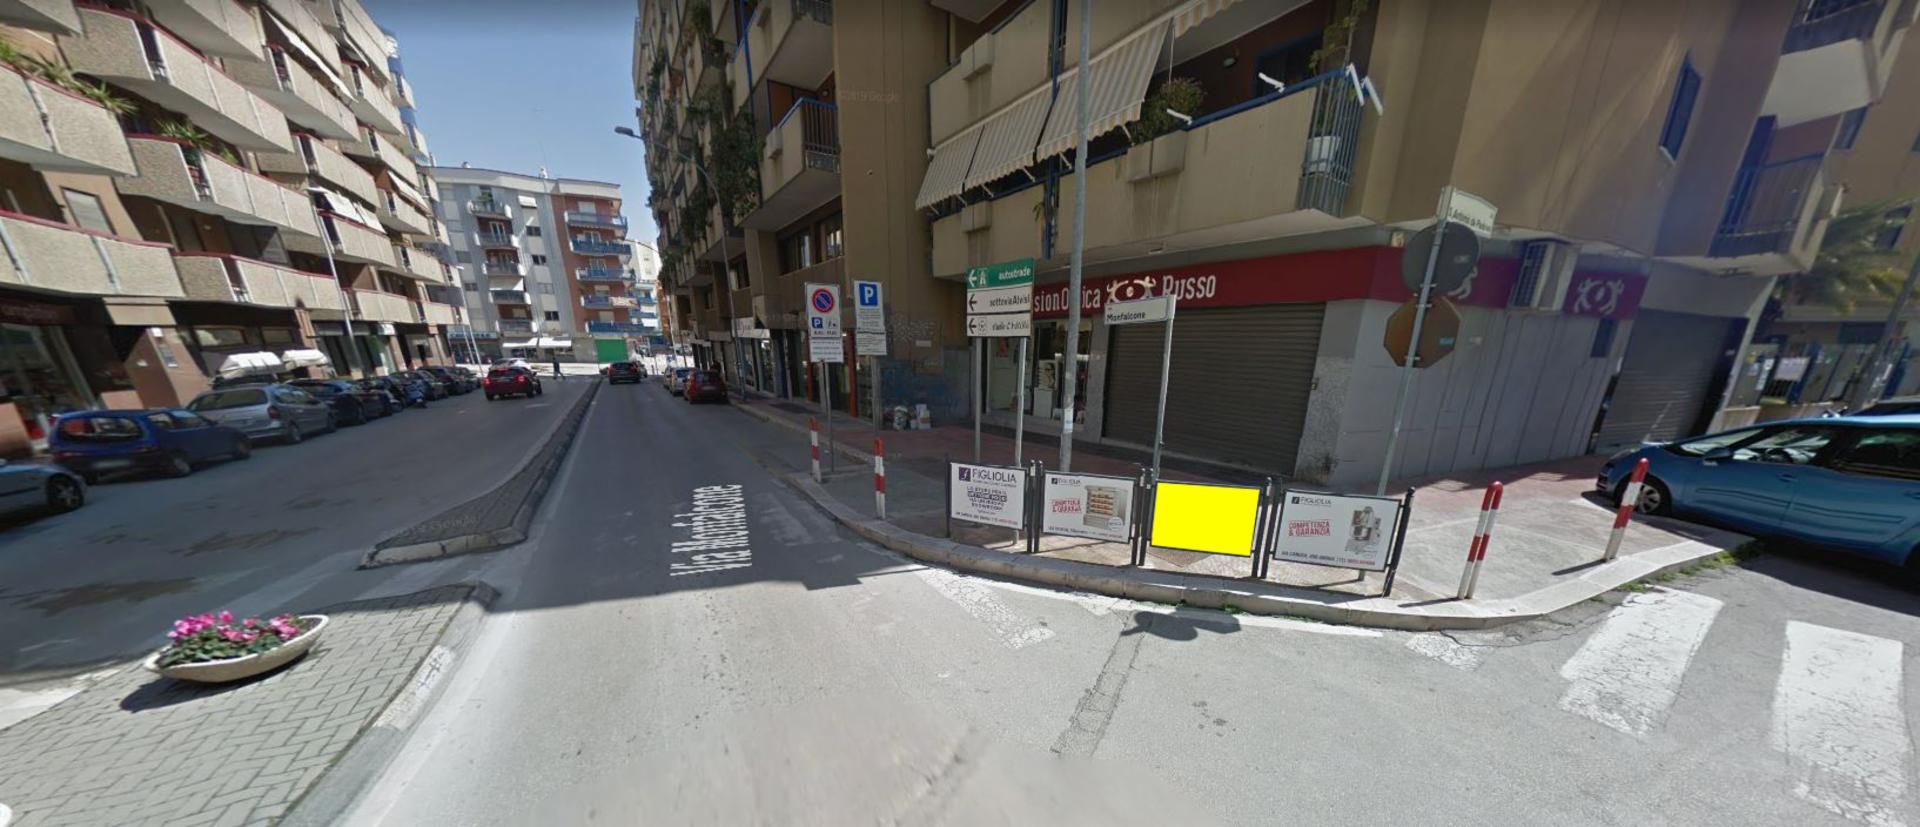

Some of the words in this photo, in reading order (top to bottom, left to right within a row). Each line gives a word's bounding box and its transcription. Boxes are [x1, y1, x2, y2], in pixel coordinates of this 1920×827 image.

[998, 266, 1031, 280] autostrade
[863, 286, 874, 304] P
[1162, 275, 1217, 300] Russo
[1034, 286, 1101, 312] sionOica
[1106, 311, 1146, 322] Monfalcone
[972, 467, 1017, 483] FIGLIOLIA
[671, 485, 749, 552] Monfalcone
[1288, 520, 1330, 529] COMPETENZA
[670, 549, 752, 576] Via
